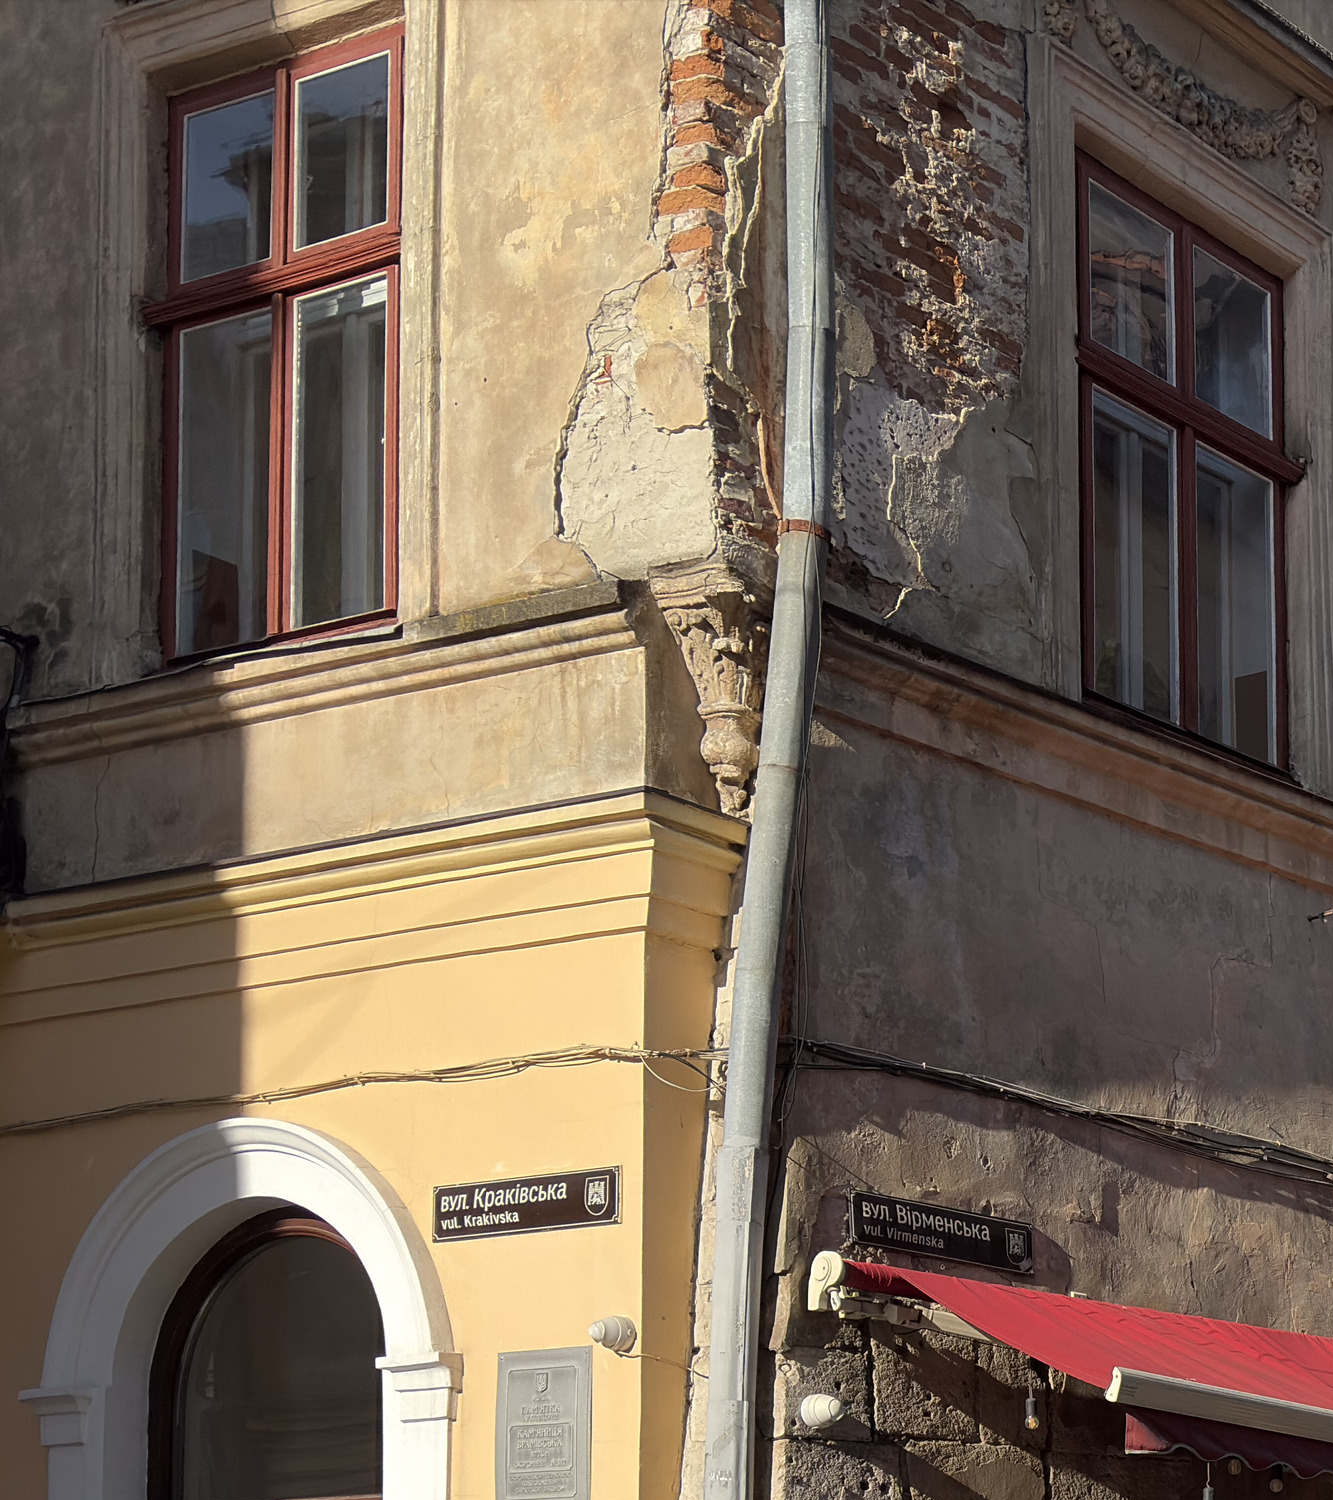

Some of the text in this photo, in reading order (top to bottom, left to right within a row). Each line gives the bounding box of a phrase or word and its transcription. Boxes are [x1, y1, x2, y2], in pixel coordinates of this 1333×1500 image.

[440, 1182, 567, 1213] вул. Краківська
[440, 1211, 520, 1230] vul. Krakivska
[862, 1201, 991, 1242] вул. Вірменська
[863, 1224, 945, 1249] vul. Virmenska
